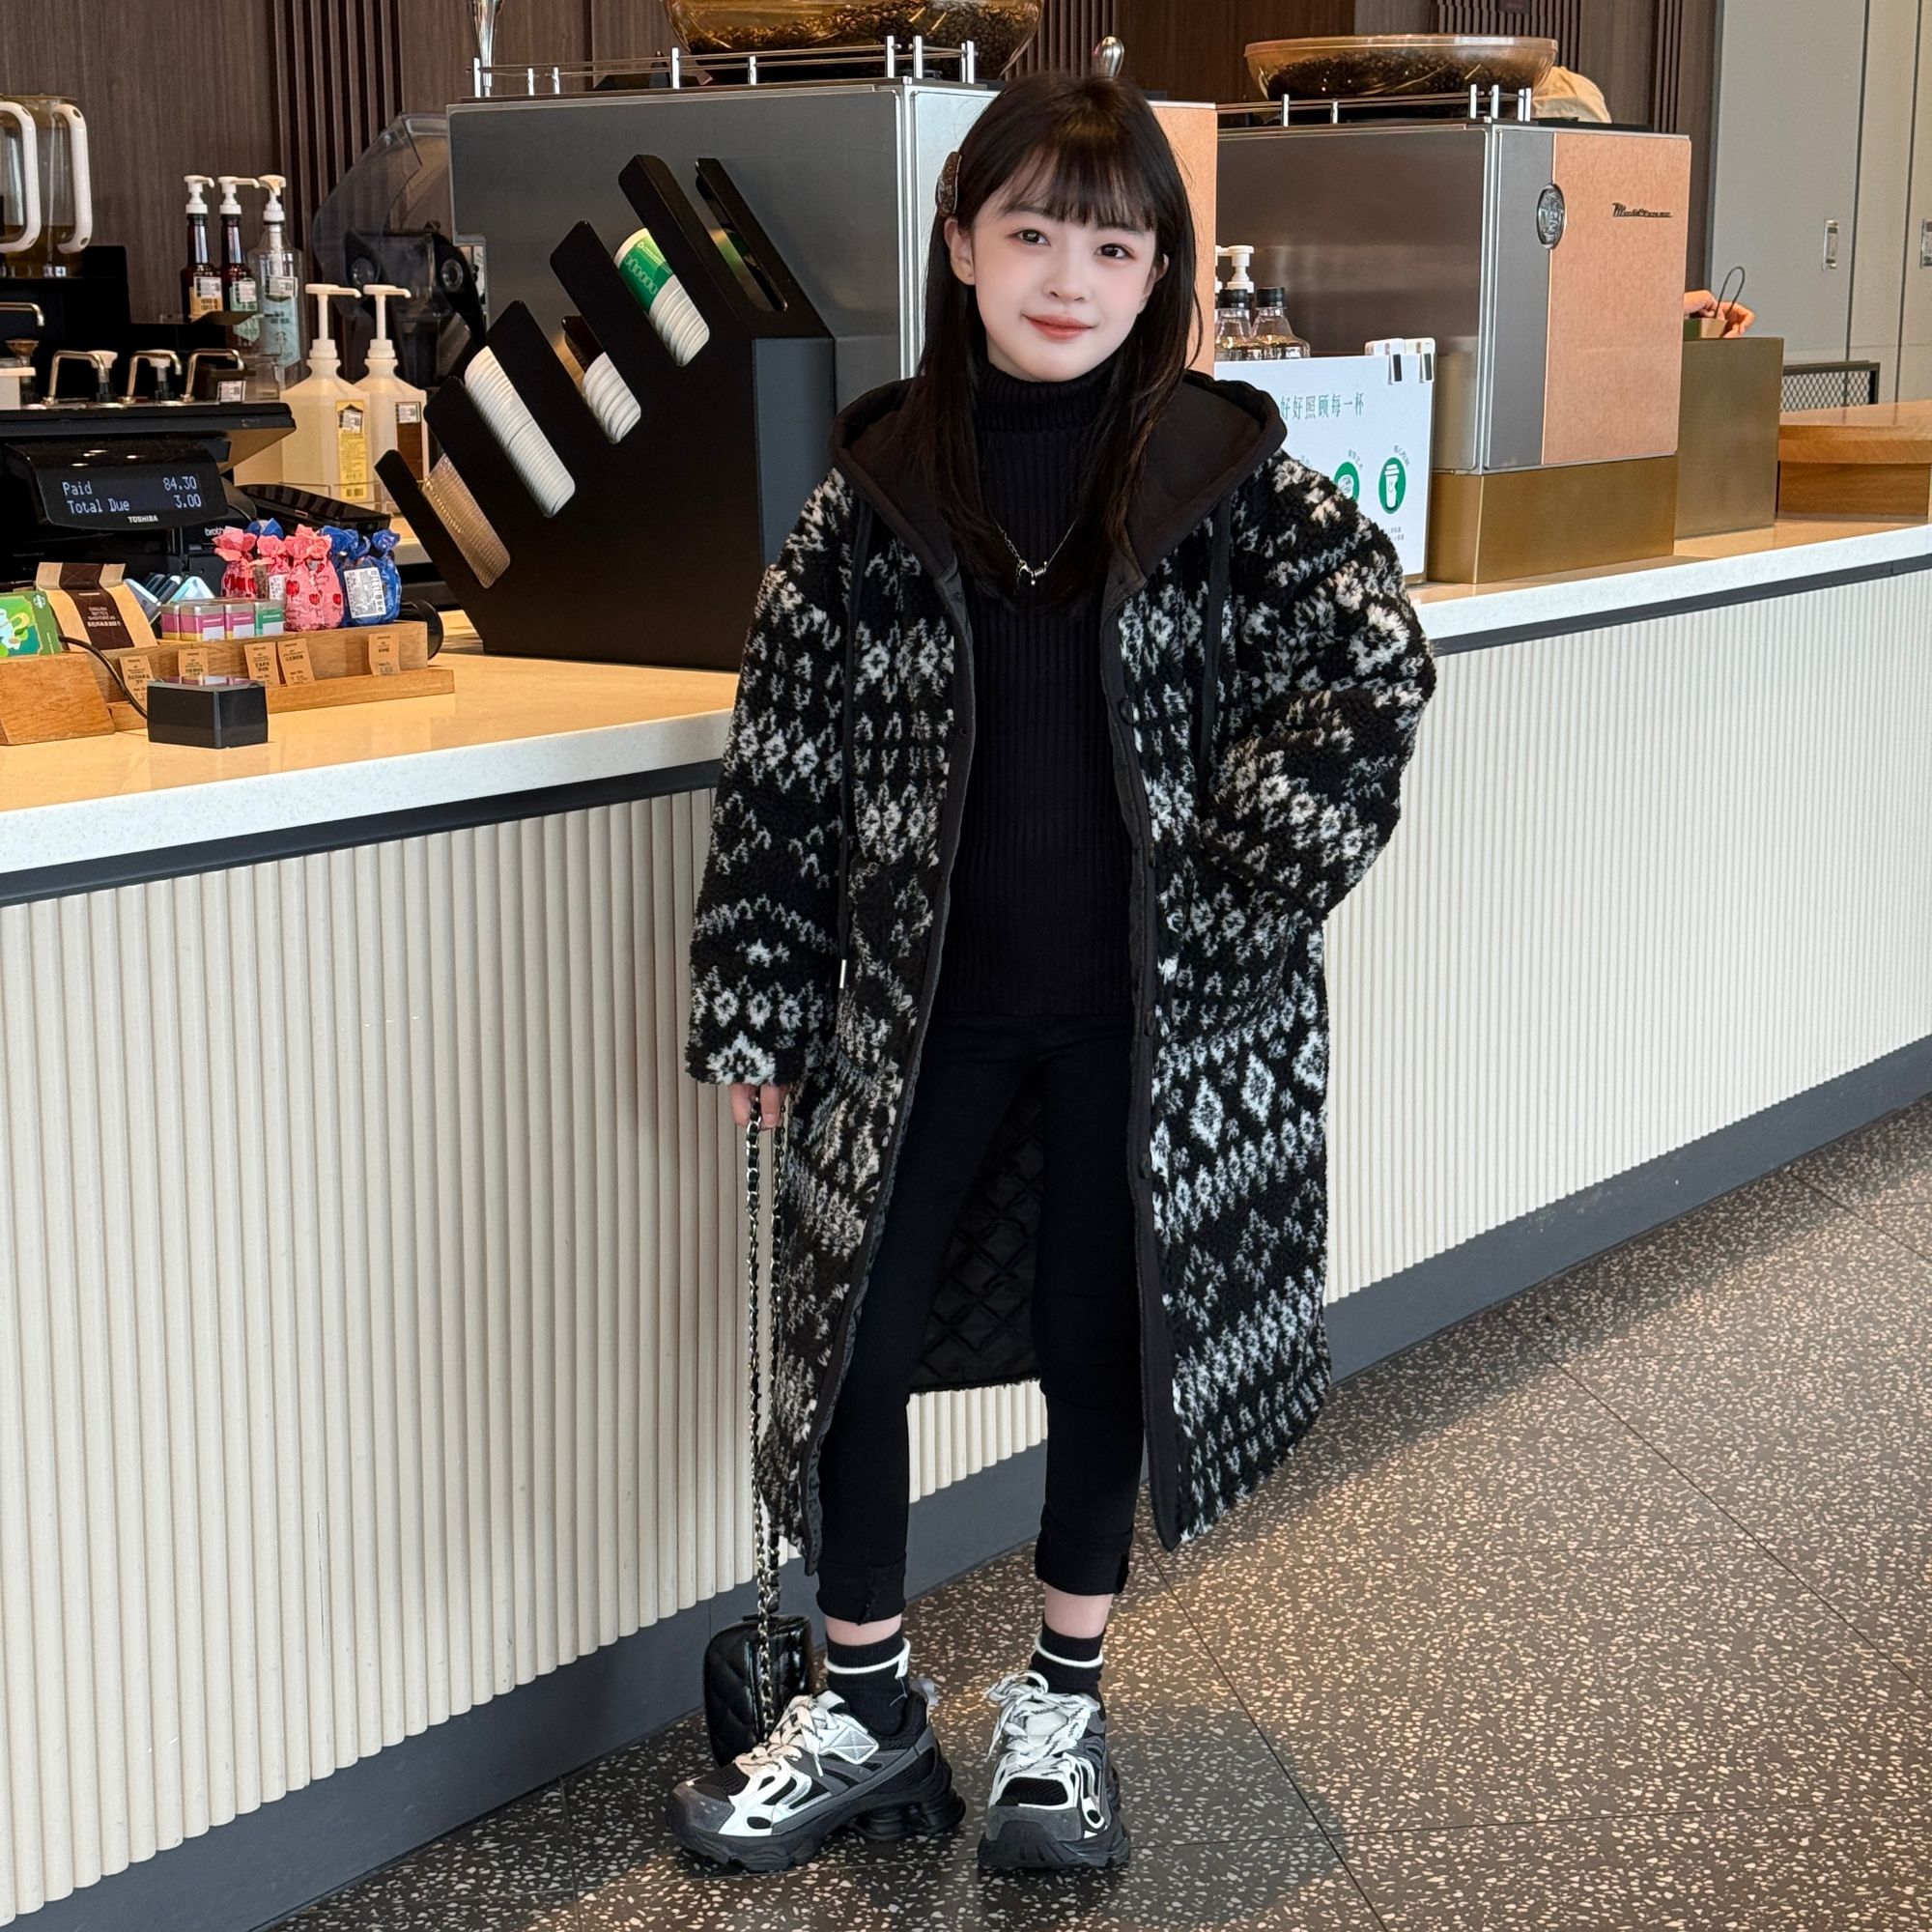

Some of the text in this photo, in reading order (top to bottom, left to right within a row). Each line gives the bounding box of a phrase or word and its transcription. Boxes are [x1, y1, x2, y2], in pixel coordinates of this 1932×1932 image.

[1280, 391, 1365, 420] 好好照顾每一杯
[62, 475, 197, 497] Paid 84.30
[67, 494, 202, 514] Total Due 3.00
[128, 515, 158, 524] TOSHIBA
